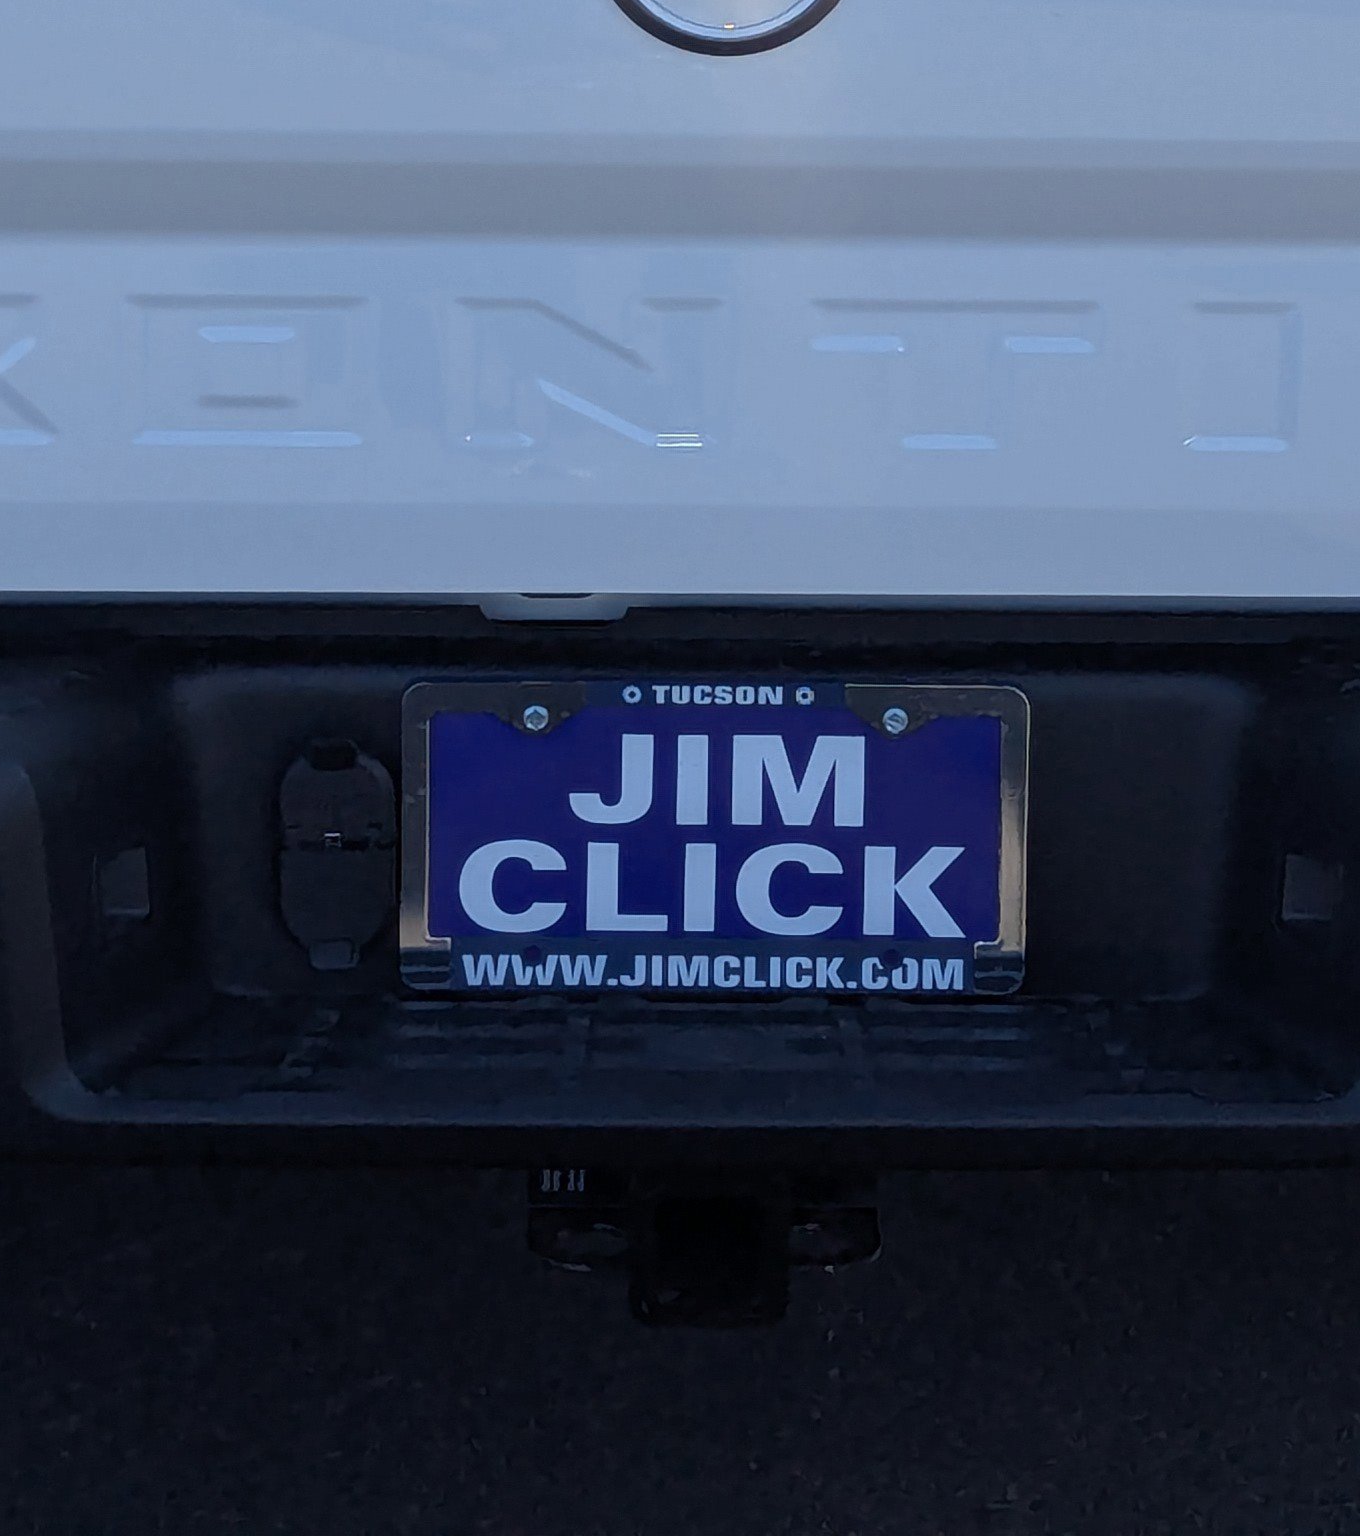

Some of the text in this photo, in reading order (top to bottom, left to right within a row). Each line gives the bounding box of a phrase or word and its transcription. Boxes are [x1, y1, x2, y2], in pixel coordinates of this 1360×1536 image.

[652, 684, 784, 706] TUCSON
[568, 733, 866, 828] JIM
[458, 838, 967, 939] CLICK
[461, 952, 965, 992] WWW.JIMCLICK.COM
